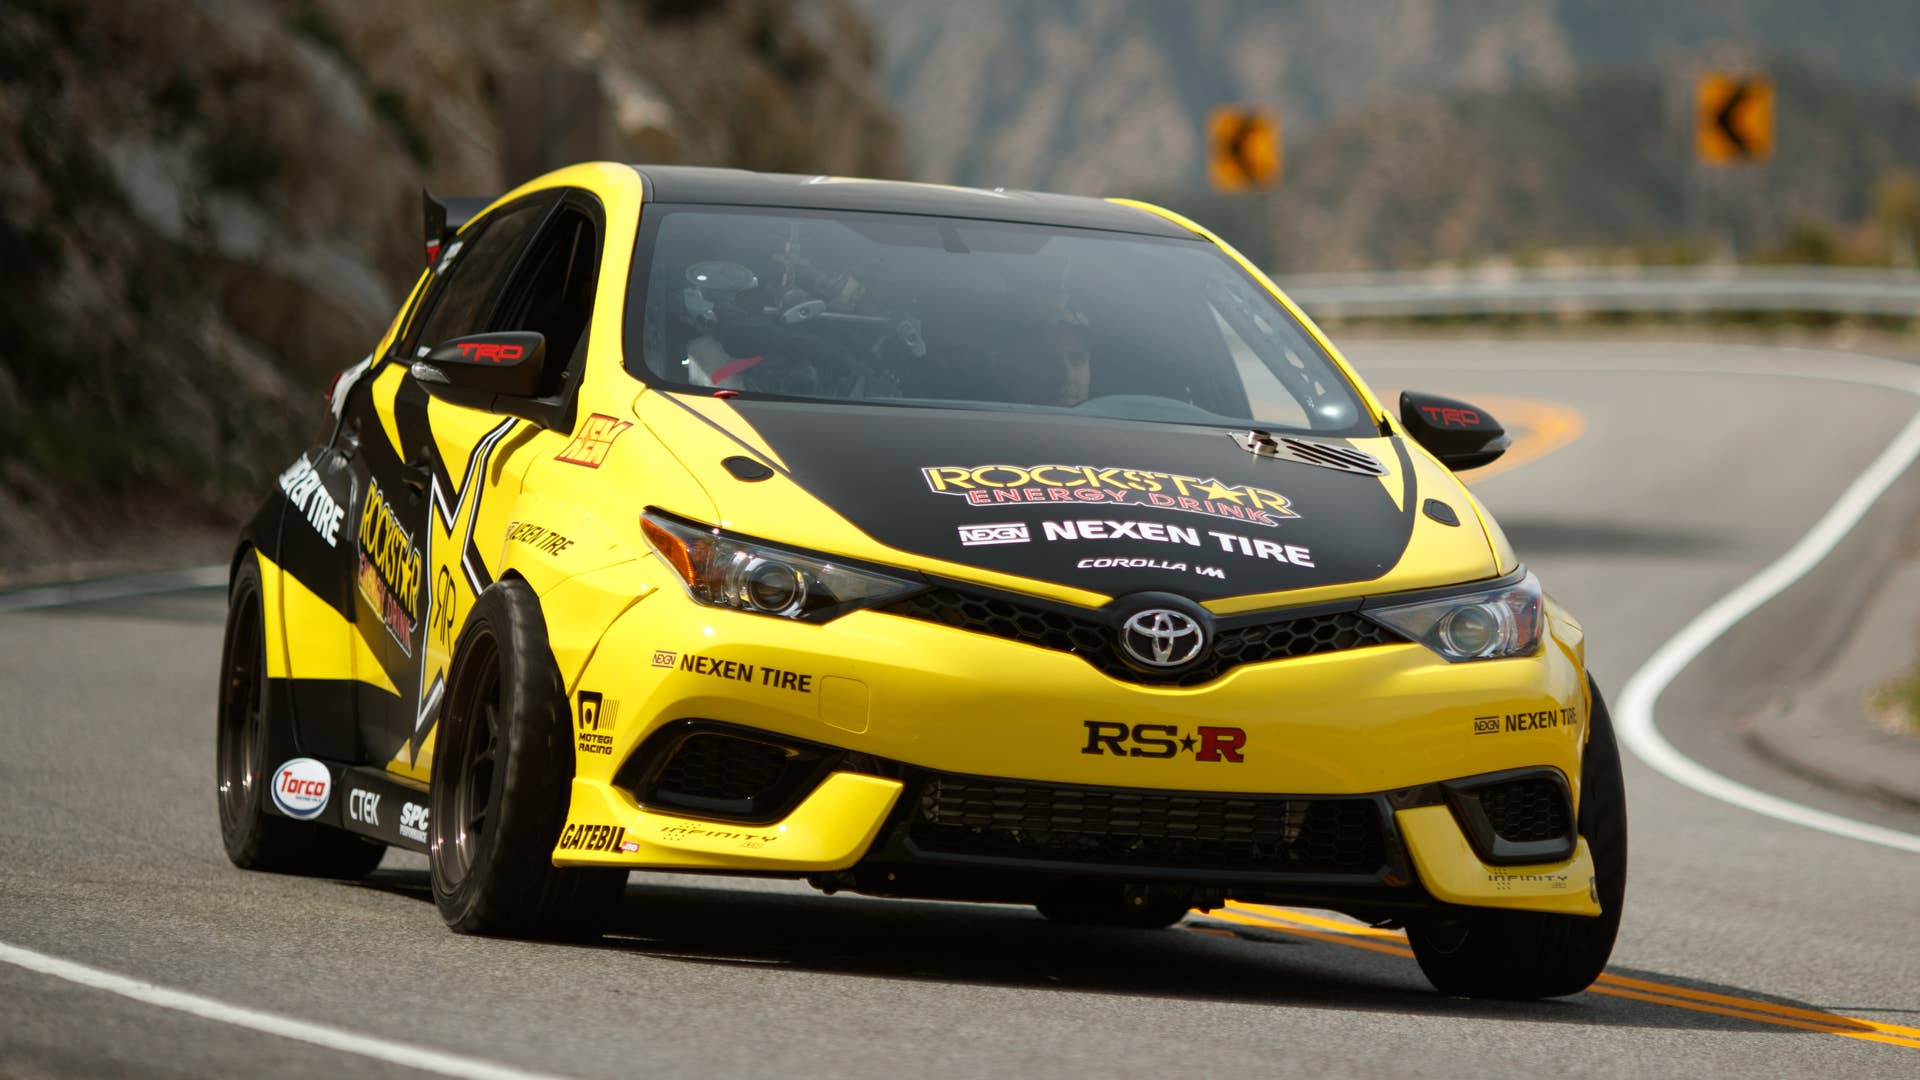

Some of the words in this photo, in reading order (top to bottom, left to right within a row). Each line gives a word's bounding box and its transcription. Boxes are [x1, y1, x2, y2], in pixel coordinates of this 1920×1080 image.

[457, 343, 523, 362] TRD
[1422, 406, 1480, 427] TRD
[926, 466, 1297, 517] ROCKSTAR
[306, 484, 345, 548] TIRE
[969, 488, 1127, 503] ENERGY
[1148, 492, 1273, 524] DRINK
[535, 531, 574, 557] TIRE
[958, 524, 1030, 544] NEXEN
[1042, 520, 1201, 547] NEXEN
[1208, 530, 1315, 568] TIRE
[1077, 558, 1187, 571] COROLLA
[680, 653, 753, 682] NEXEN
[760, 666, 812, 693] TIRE
[1505, 710, 1557, 732] NEXEN
[578, 742, 612, 755] RACING
[579, 732, 613, 744] MOTEGI
[282, 771, 326, 797] Torco
[350, 788, 381, 826] CTEK
[400, 801, 429, 831] SPC
